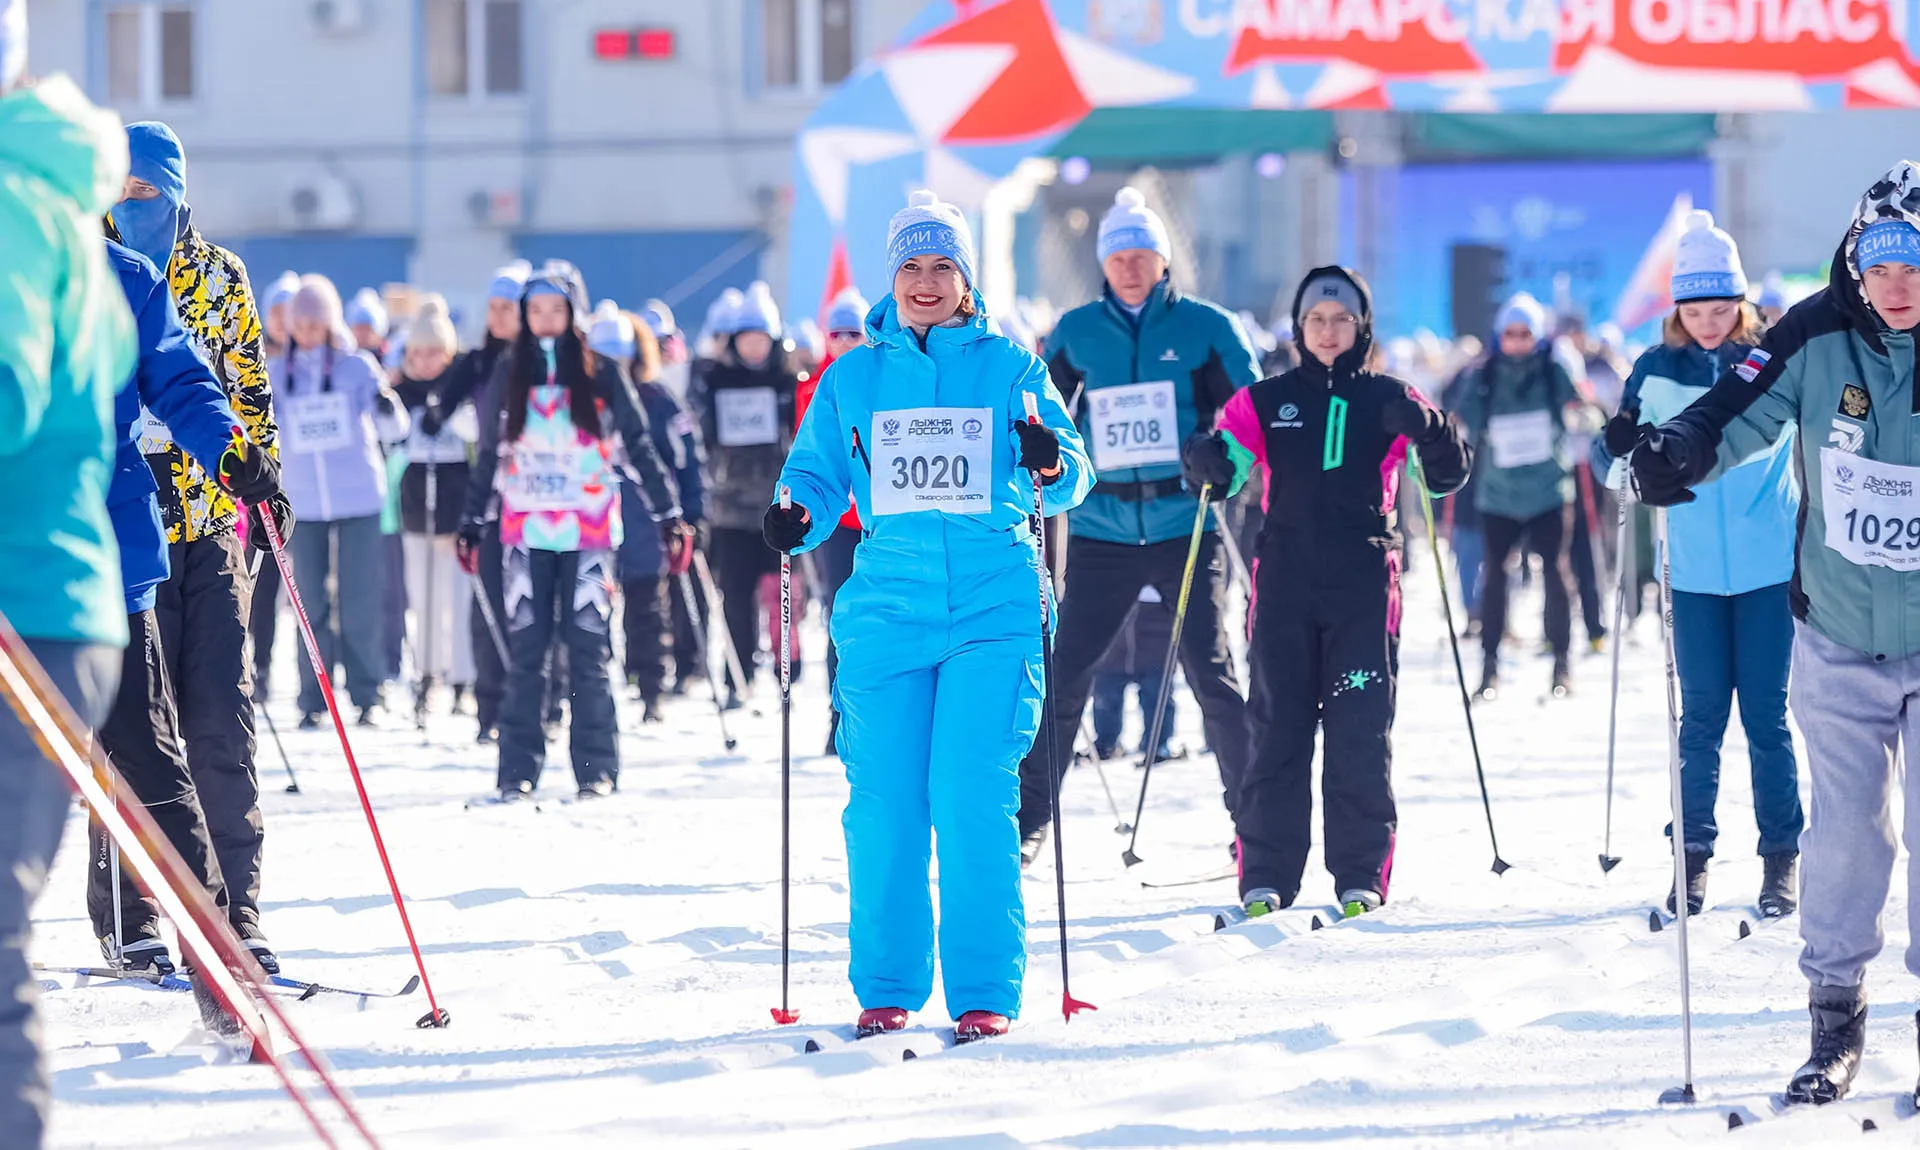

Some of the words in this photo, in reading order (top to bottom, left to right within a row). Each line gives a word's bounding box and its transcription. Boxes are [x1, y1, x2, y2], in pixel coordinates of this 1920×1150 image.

[1178, 0, 1615, 42] САМАРСКАЯ
[908, 427, 954, 436] РОССИИ
[910, 419, 952, 427] ЛЫЖНЯ
[1106, 420, 1161, 447] 5708
[892, 455, 969, 489] 3020
[1865, 475, 1912, 489] ЛЫЖНЯ
[1863, 482, 1913, 497] РОССИИ
[1845, 508, 1920, 551] 1029
[145, 622, 154, 666] CRAFT
